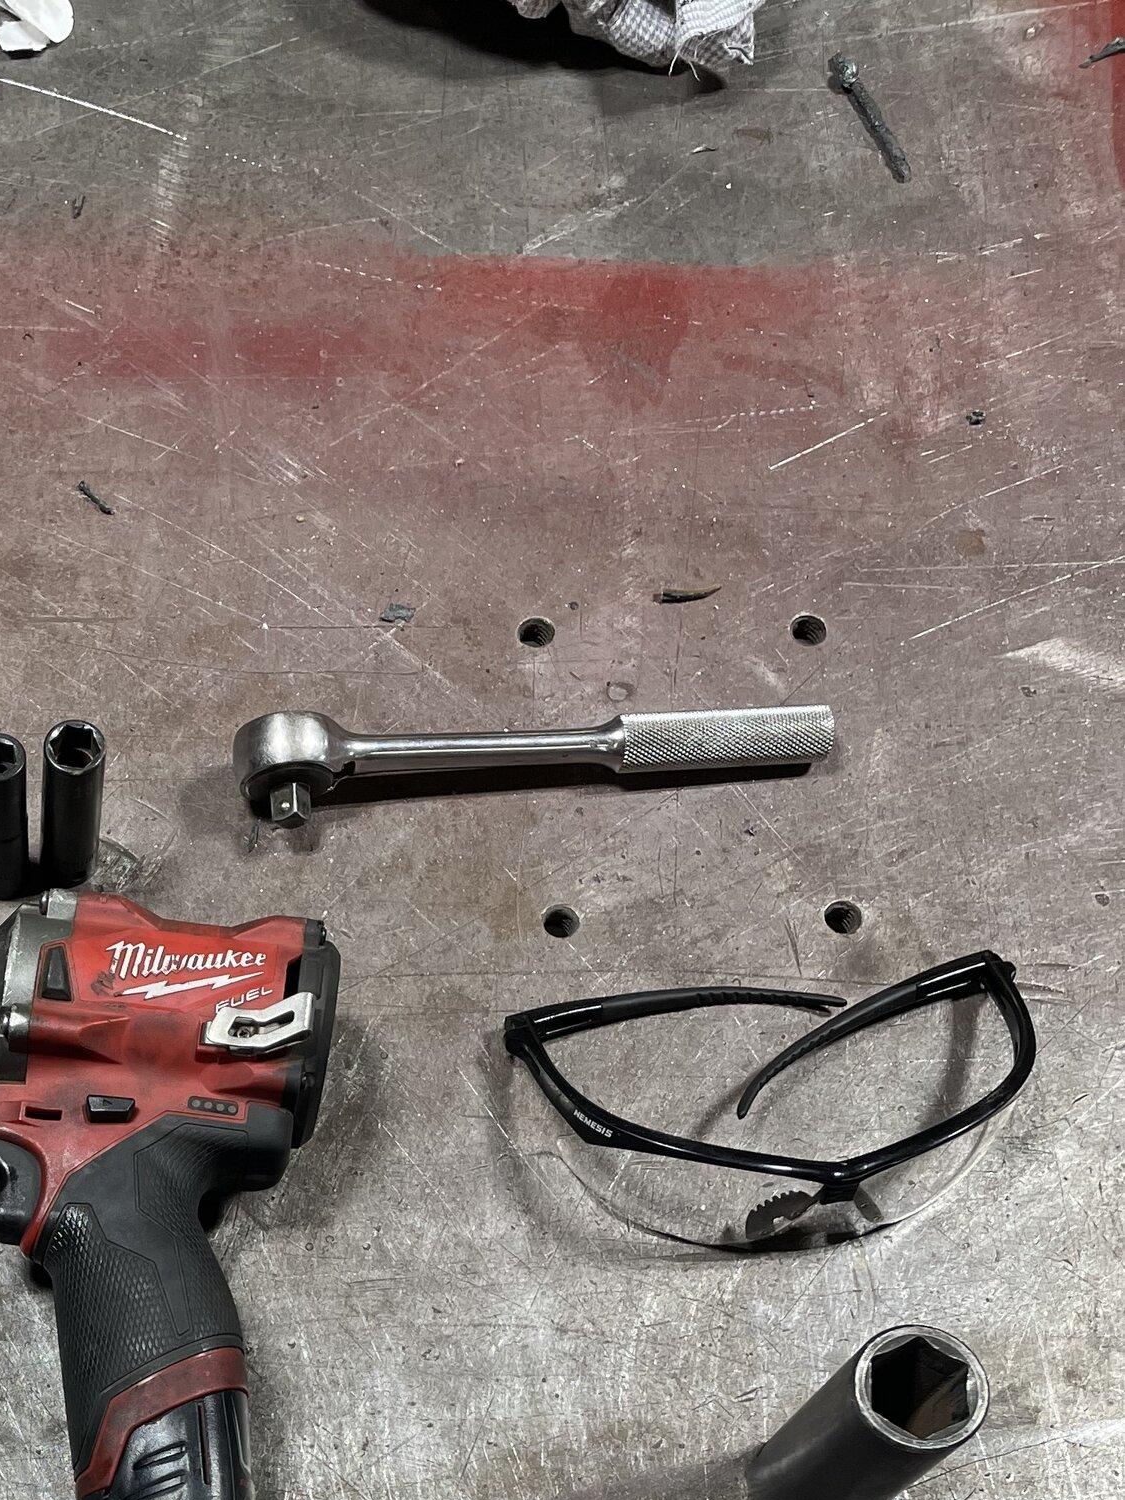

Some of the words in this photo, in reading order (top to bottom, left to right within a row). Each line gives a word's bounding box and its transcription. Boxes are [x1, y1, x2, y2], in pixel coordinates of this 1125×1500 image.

[105, 940, 267, 979] Milwaukee
[215, 986, 273, 1013] FUEL
[573, 1109, 613, 1138] NEMESIS
